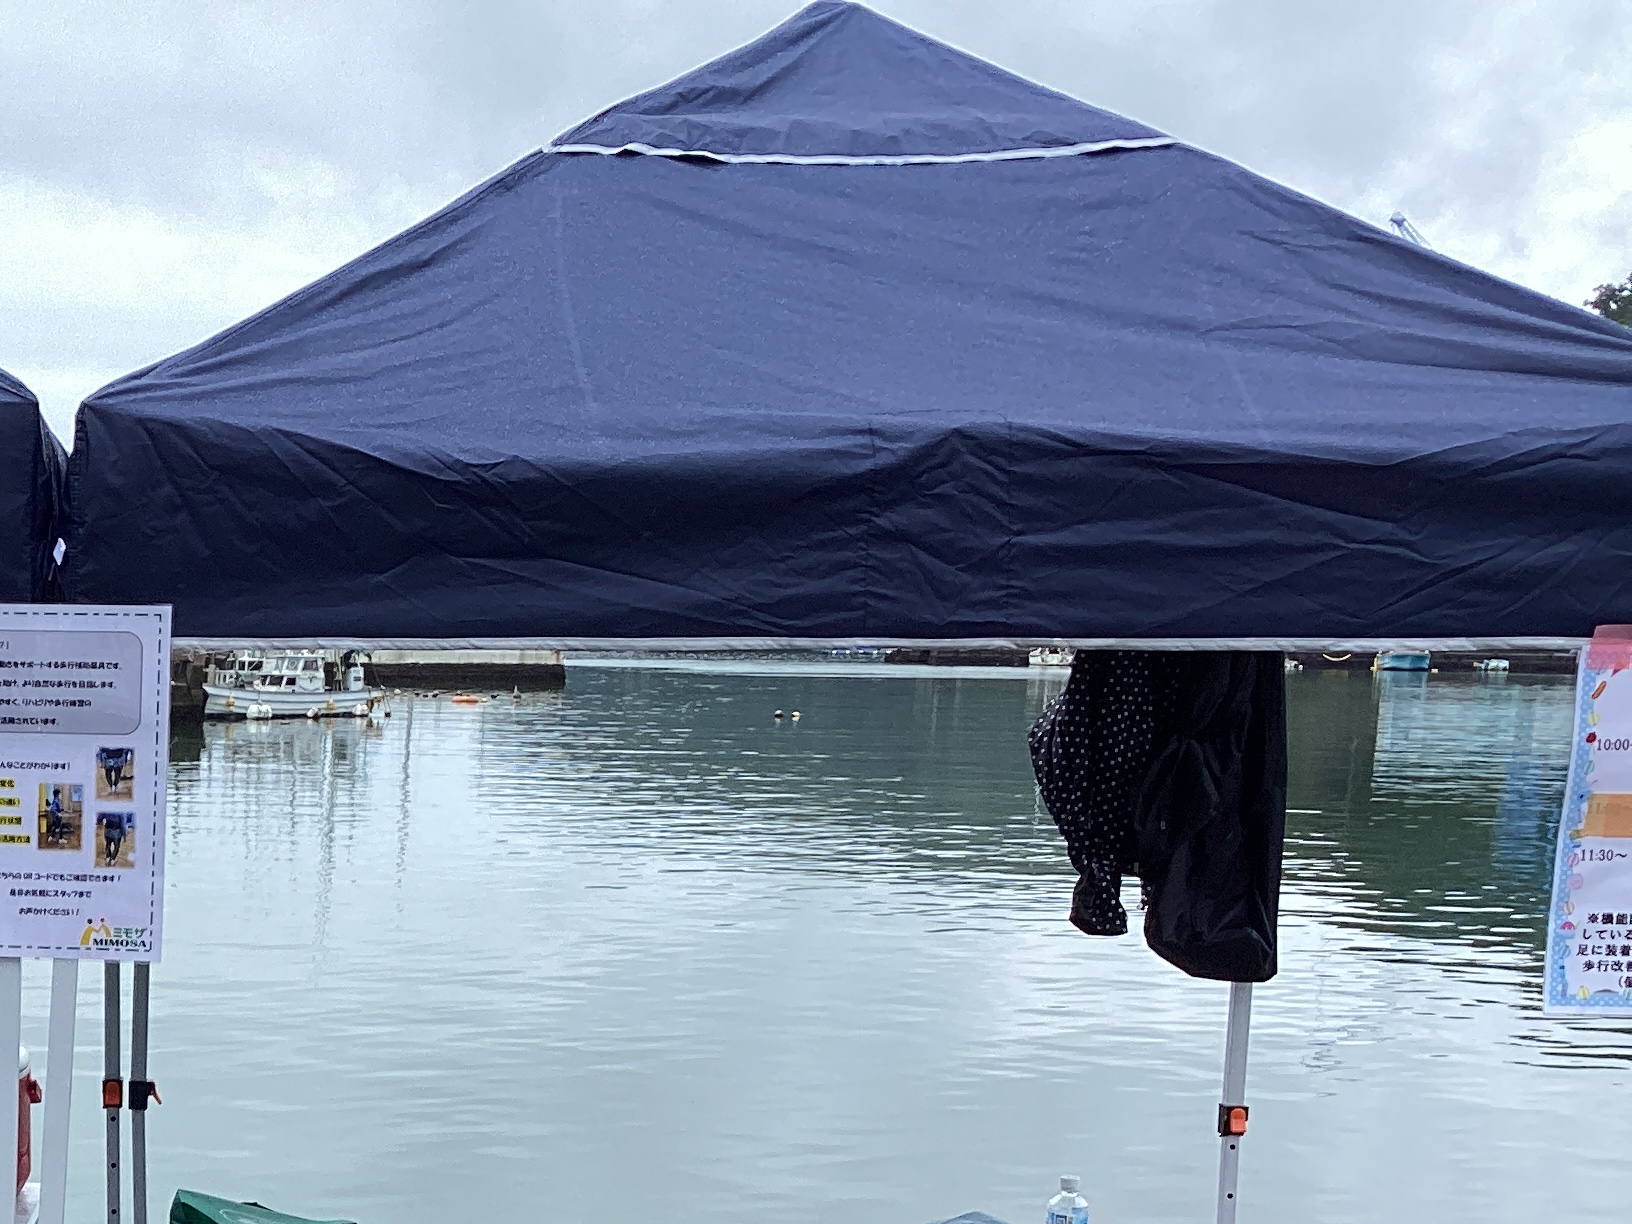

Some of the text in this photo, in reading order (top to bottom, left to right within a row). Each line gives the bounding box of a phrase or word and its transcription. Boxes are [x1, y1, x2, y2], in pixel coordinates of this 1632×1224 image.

[1596, 737, 1632, 751] 10:00
[112, 927, 148, 938] ミモザ
[93, 938, 147, 948] MIMOSA
